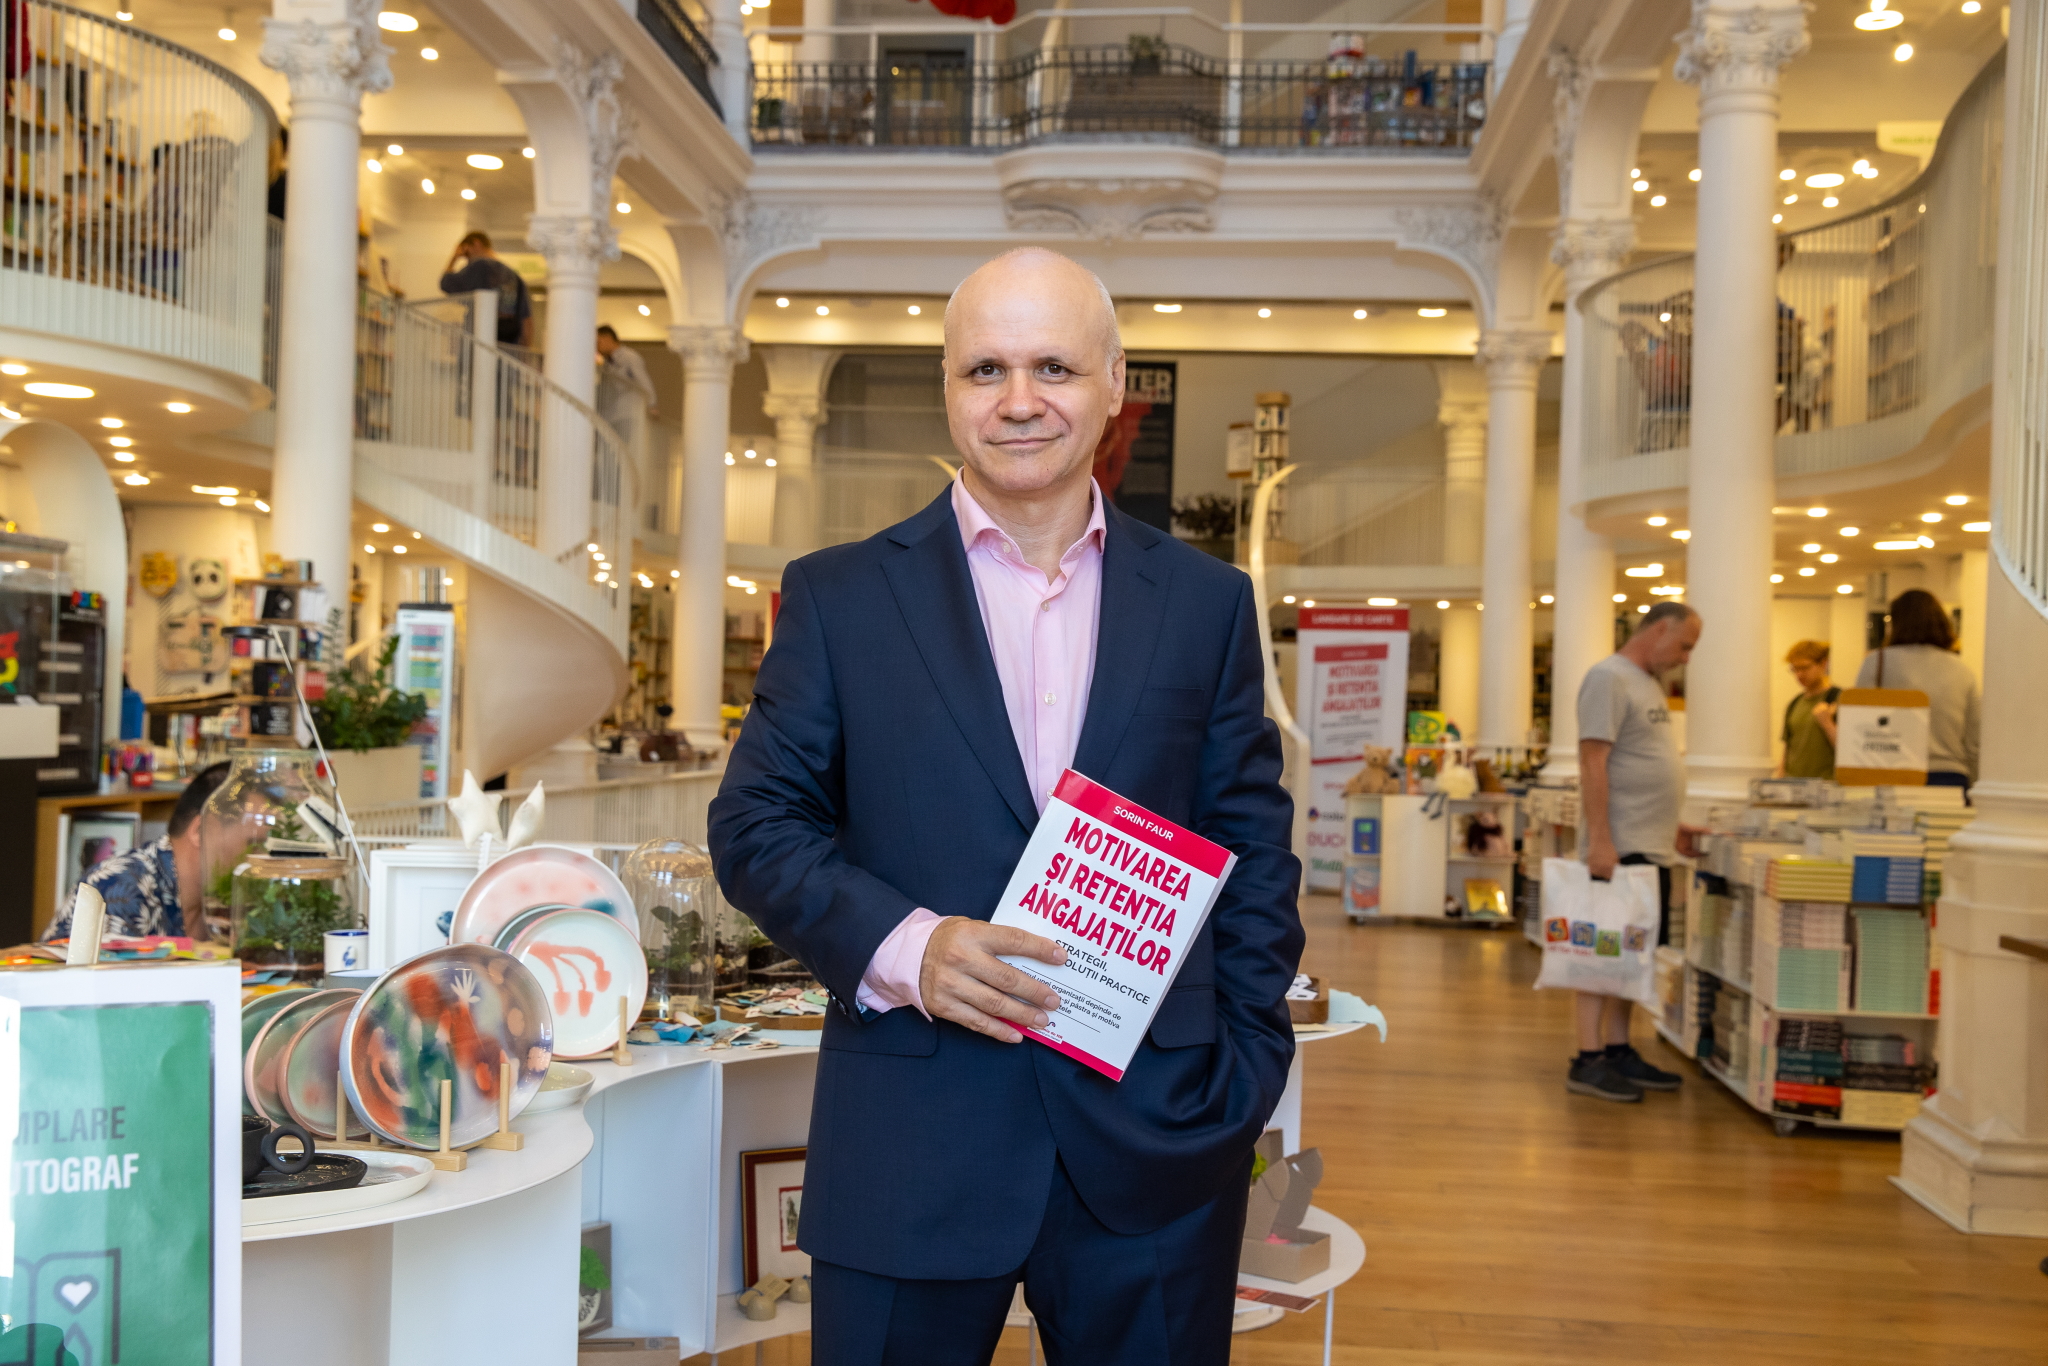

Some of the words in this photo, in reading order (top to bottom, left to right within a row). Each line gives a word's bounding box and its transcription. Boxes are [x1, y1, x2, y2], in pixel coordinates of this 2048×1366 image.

[1127, 369, 1172, 392] TER
[1113, 806, 1146, 828] SORIN
[1145, 822, 1174, 842] FAUR
[1063, 816, 1192, 902] MOTIVAREA
[1045, 852, 1074, 887] ȘI
[1069, 863, 1177, 938] RETENȚIA
[1018, 882, 1172, 976] ANGAJAȚILOR
[1064, 958, 1099, 980] OLUȚII
[1099, 975, 1151, 1006] PRACTICE
[1051, 984, 1086, 1004] organizații
[1085, 998, 1112, 1017] depinde
[1112, 1010, 1122, 1021] de
[1058, 1004, 1072, 1015] tele
[1069, 1000, 1091, 1015] păstra
[1098, 1014, 1120, 1029] motiva
[13, 1105, 126, 1145] MPLARE
[10, 1153, 140, 1197] UTOGRAF
